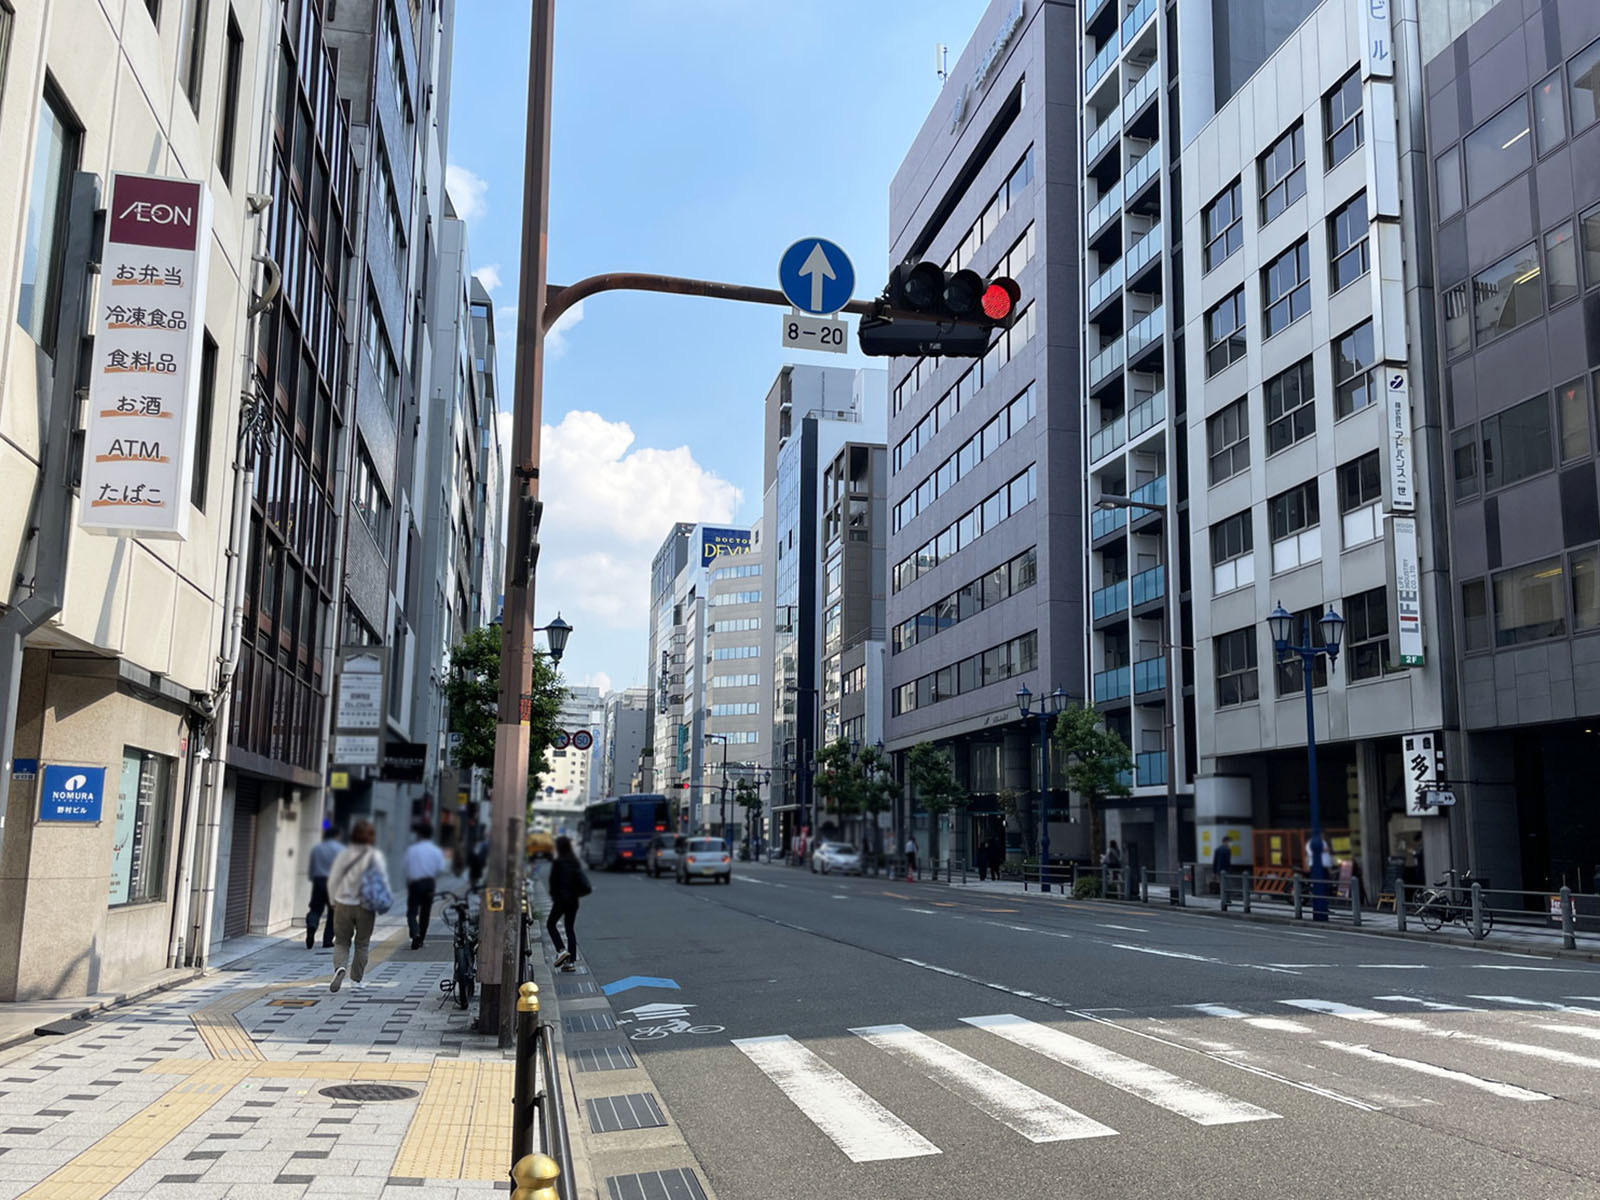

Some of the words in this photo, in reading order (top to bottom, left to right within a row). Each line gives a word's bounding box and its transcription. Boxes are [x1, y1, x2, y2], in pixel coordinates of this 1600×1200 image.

[117, 263, 183, 287] お弁当
[105, 305, 187, 330] 冷凍食品
[107, 348, 177, 373] 食料品
[117, 395, 162, 416] お酒
[107, 438, 160, 460] ATM
[99, 482, 161, 505] たばこ
[1400, 590, 1419, 633] LIFE
[1406, 655, 1417, 664] 2F
[577, 735, 588, 745] 50
[52, 791, 94, 800] NOMURA
